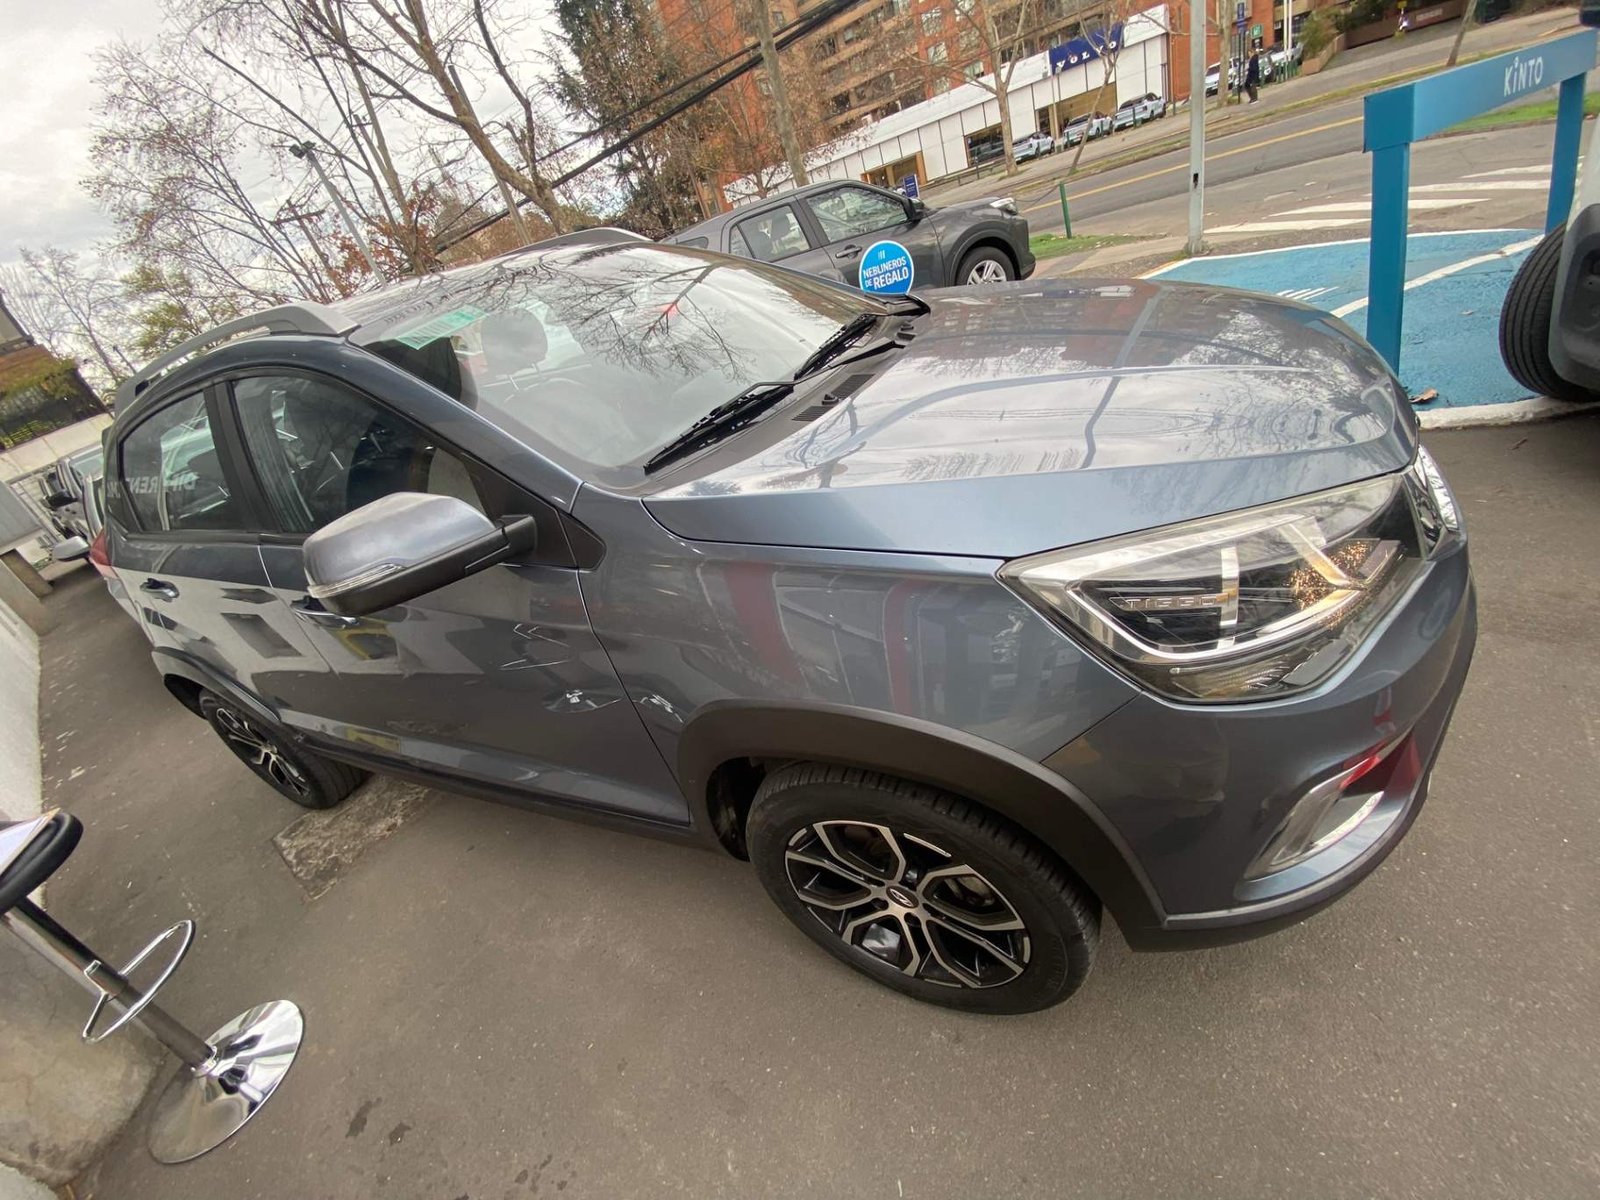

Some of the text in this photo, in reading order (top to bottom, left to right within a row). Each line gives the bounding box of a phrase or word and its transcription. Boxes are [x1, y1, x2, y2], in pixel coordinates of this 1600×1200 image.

[1056, 41, 1117, 69] VOLVO
[863, 256, 907, 279] NEBLINEROS
[865, 266, 909, 290] DE REGALO
[1126, 596, 1214, 609] TIGGO
